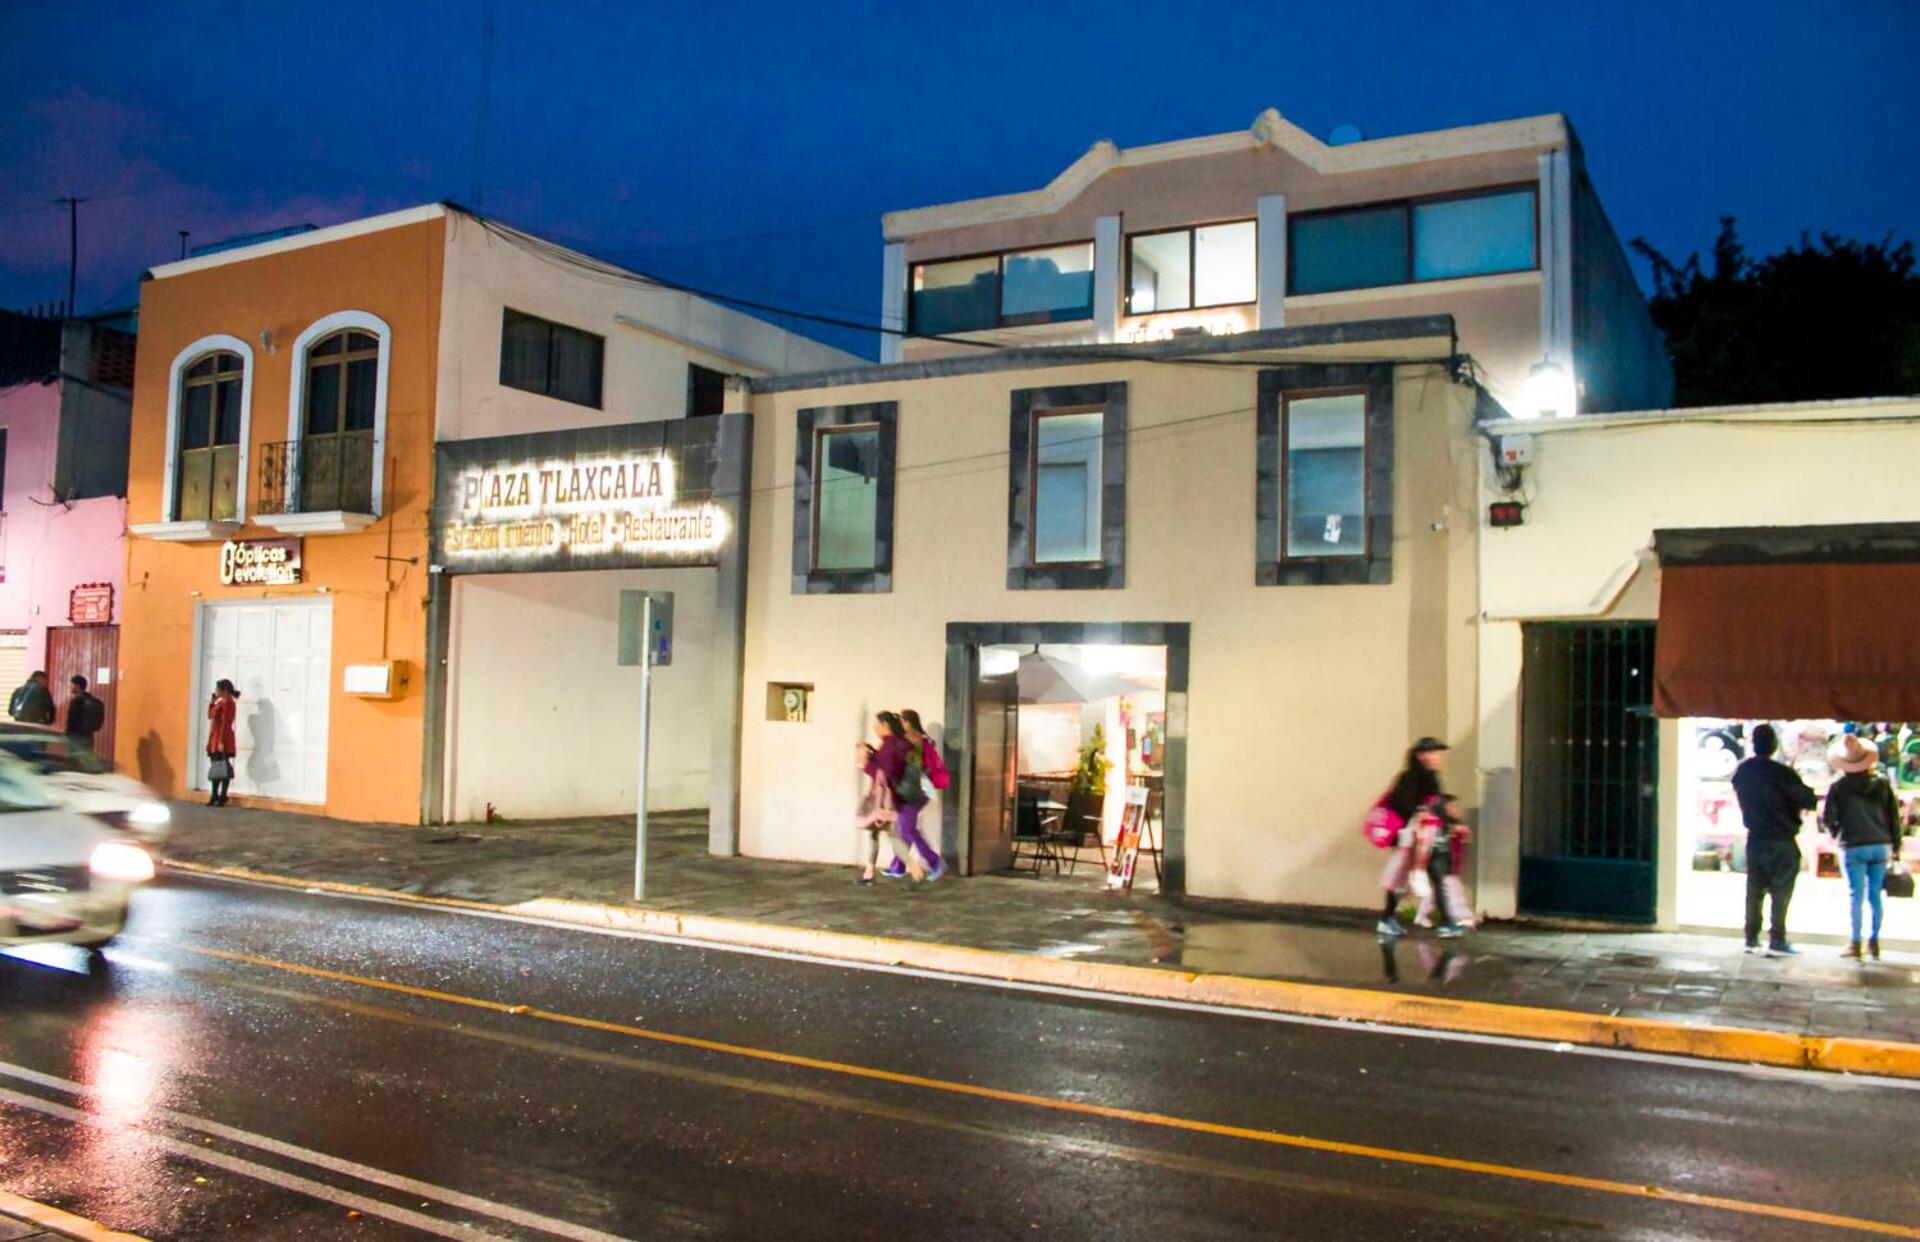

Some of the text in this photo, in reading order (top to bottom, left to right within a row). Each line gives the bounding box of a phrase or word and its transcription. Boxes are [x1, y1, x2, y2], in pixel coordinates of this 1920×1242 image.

[463, 462, 665, 509] PLAZA TLAXCALA
[569, 512, 606, 544] Hotel
[624, 508, 712, 543] Restaurante
